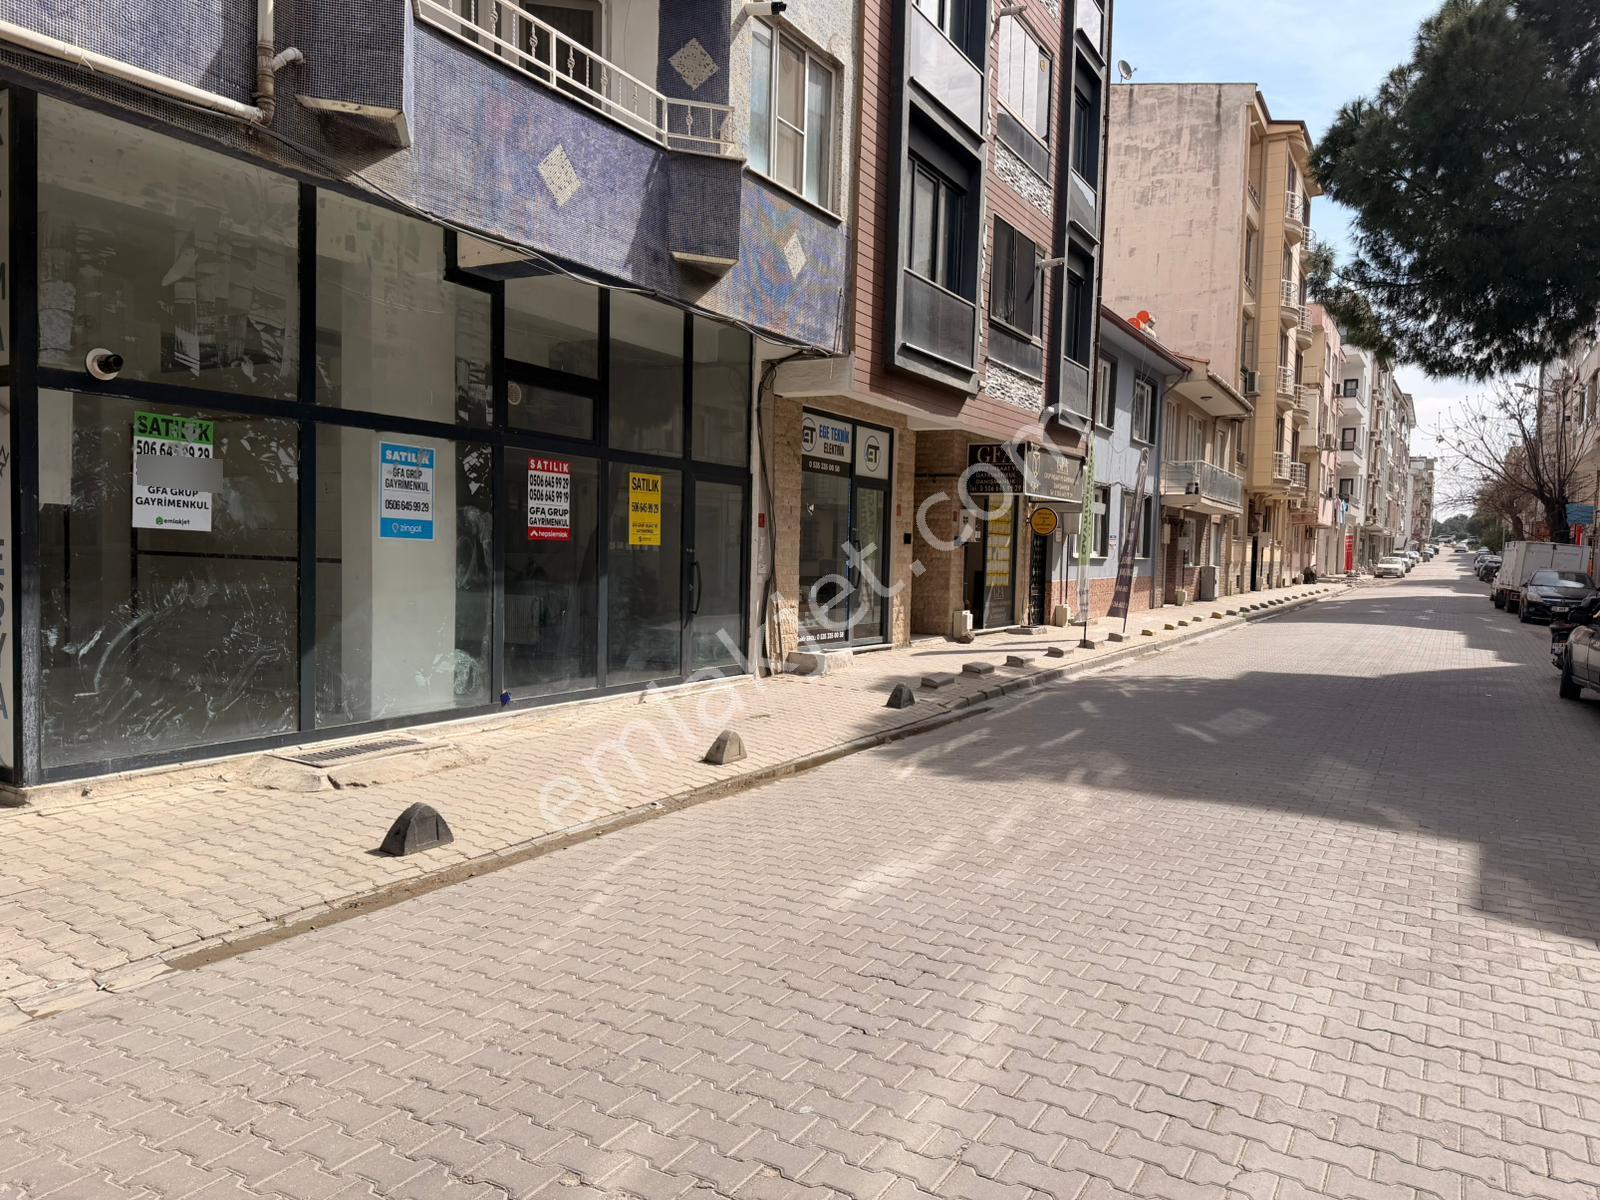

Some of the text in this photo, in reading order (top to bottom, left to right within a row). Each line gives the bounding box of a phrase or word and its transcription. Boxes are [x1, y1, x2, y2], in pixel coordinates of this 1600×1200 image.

[819, 424, 829, 440] EGE
[530, 459, 569, 473] SATILIK
[529, 473, 544, 487] 0506
[631, 477, 659, 492] SATILIK
[529, 488, 544, 502] 0506
[135, 497, 209, 510] GAYRİMENKUL
[385, 499, 401, 510] 0506
[529, 506, 569, 517] GFA GRUP
